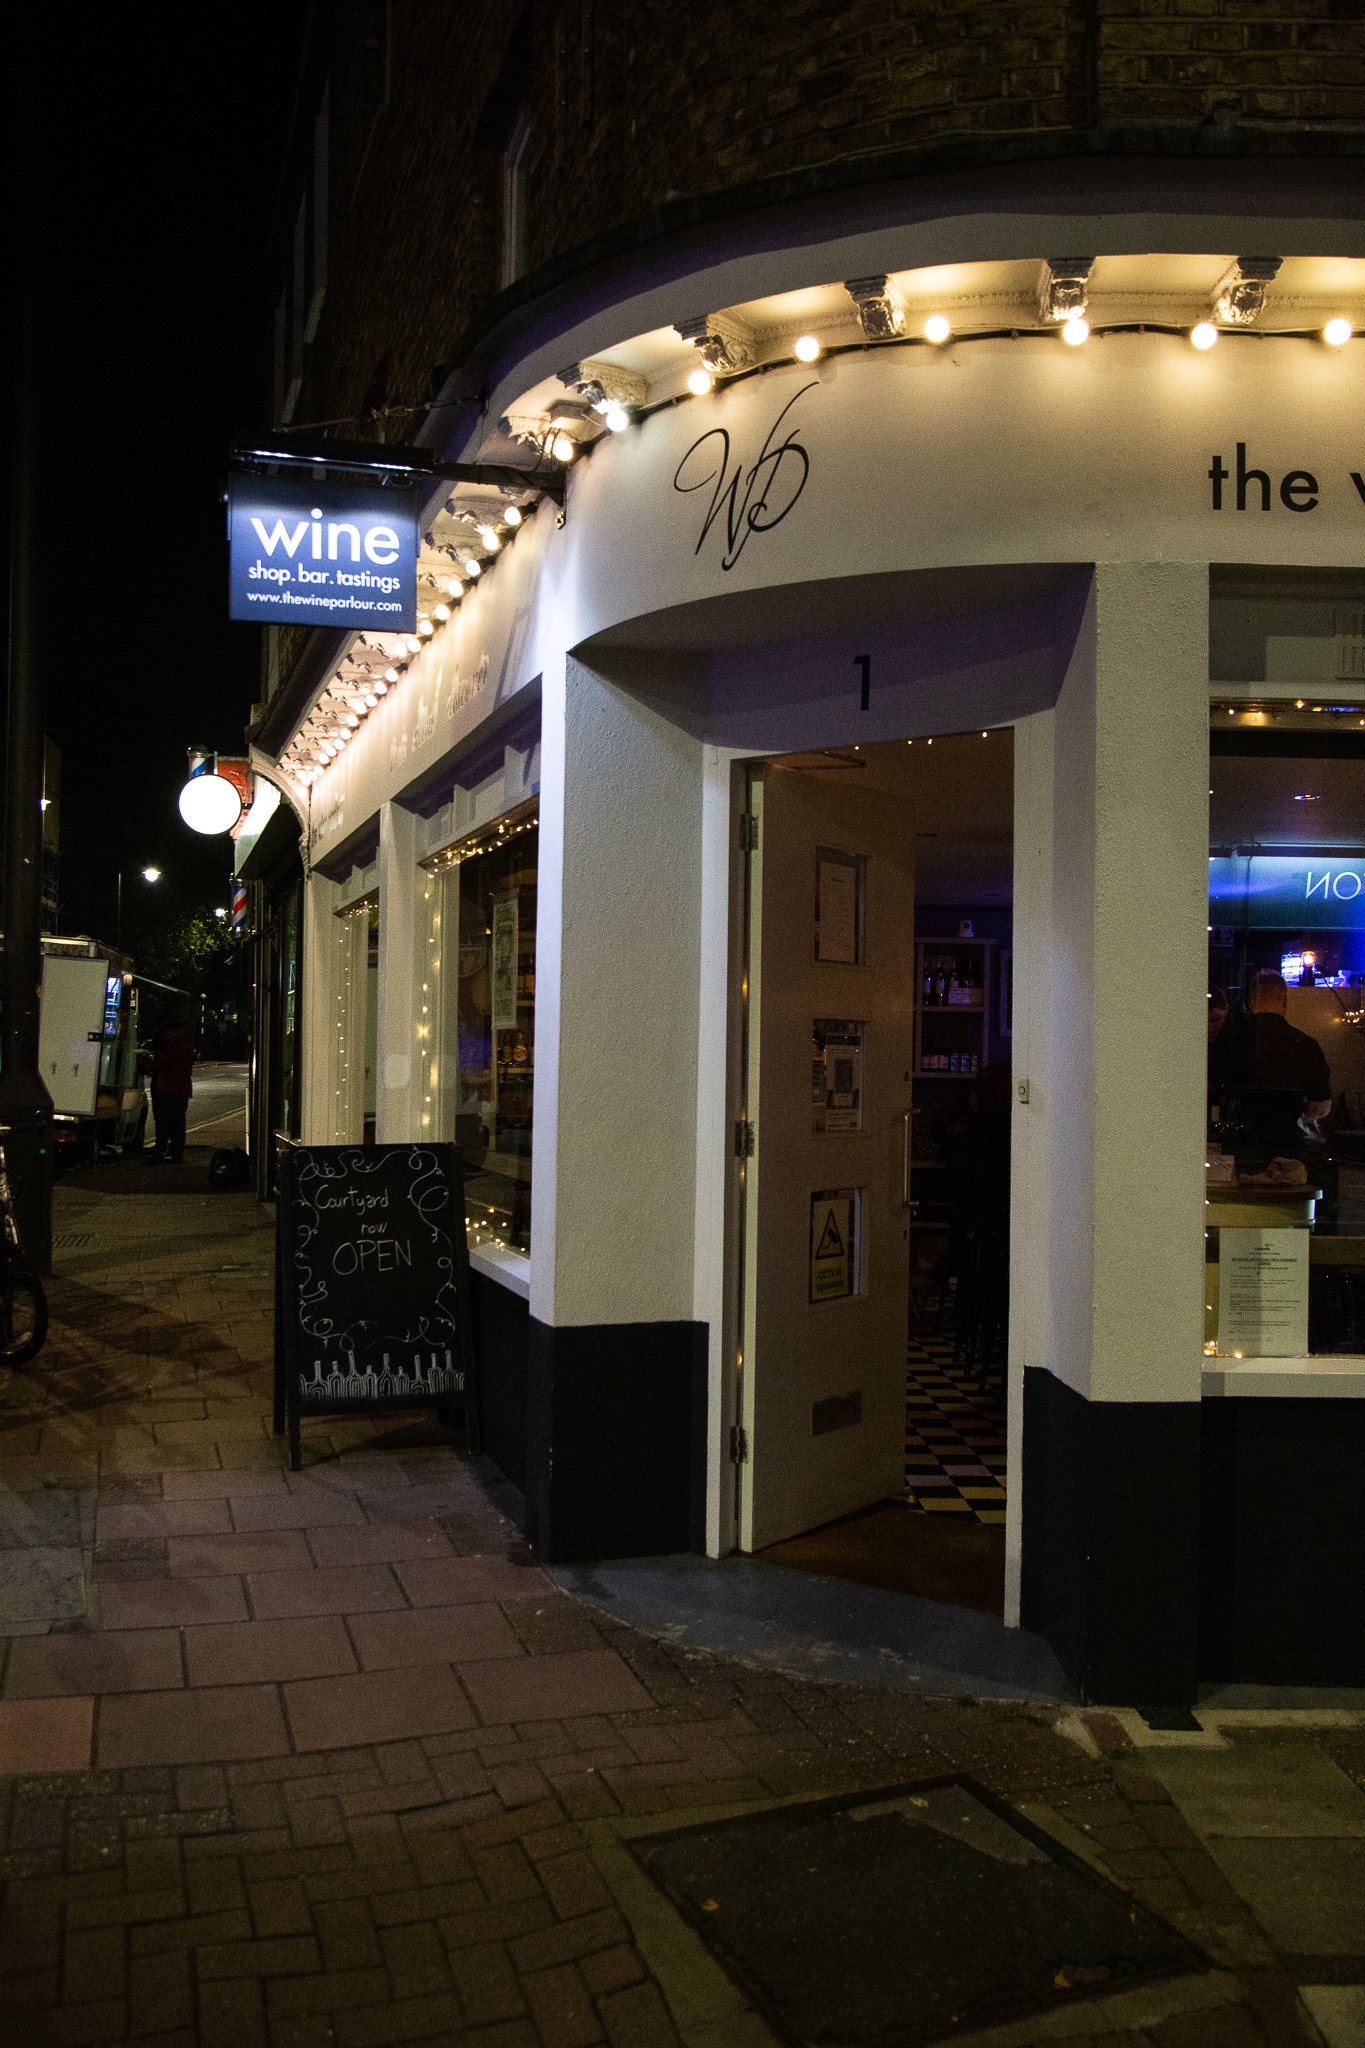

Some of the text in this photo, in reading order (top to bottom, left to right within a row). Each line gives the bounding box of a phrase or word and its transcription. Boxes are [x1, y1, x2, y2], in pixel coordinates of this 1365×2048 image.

[1208, 442, 1319, 513] the
[250, 507, 400, 565] wine
[336, 570, 401, 594] tastings
[247, 591, 402, 612] www.thewineparlour.com
[852, 654, 871, 712] 1
[314, 1184, 389, 1216] Courtyard
[360, 1221, 389, 1235] now
[332, 1238, 412, 1276] OPEN
